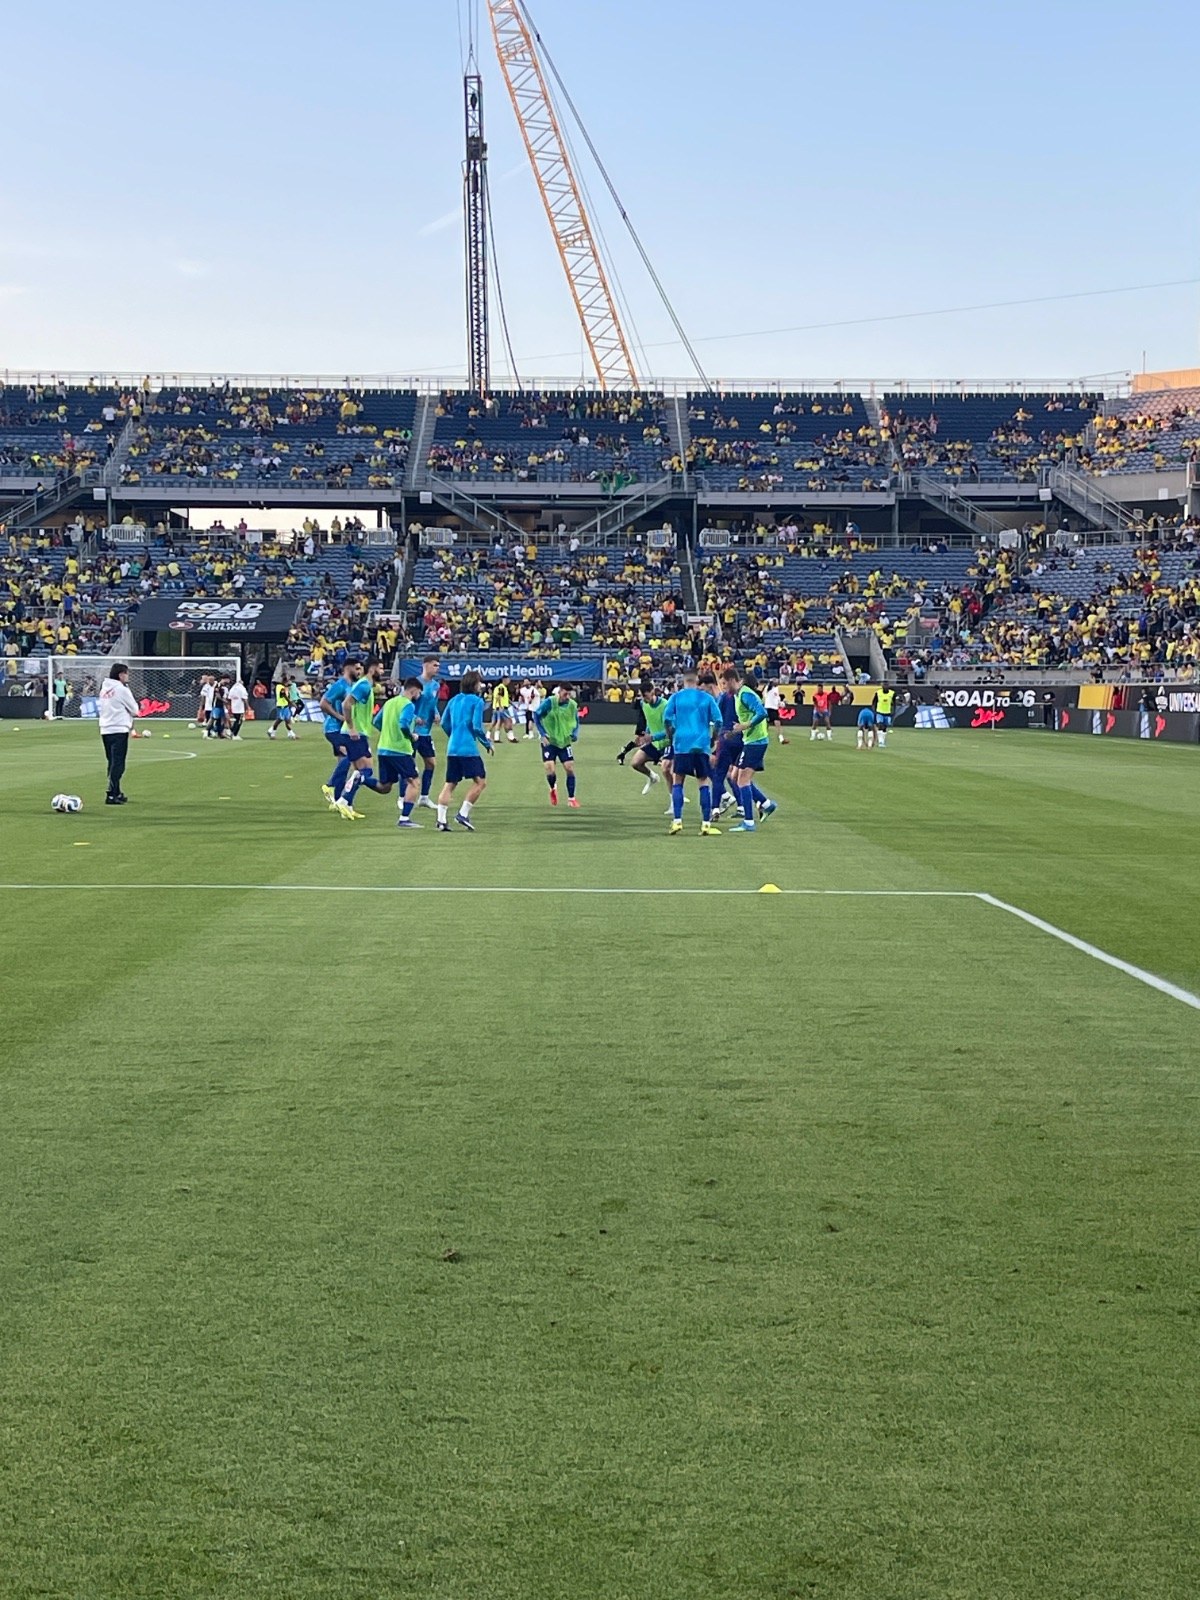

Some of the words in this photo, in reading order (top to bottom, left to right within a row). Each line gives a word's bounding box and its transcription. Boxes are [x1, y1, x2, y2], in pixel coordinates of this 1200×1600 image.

[178, 602, 264, 611] ROAD
[206, 610, 262, 619] 26
[945, 690, 994, 707] ROAD
[995, 697, 1010, 707] TO
